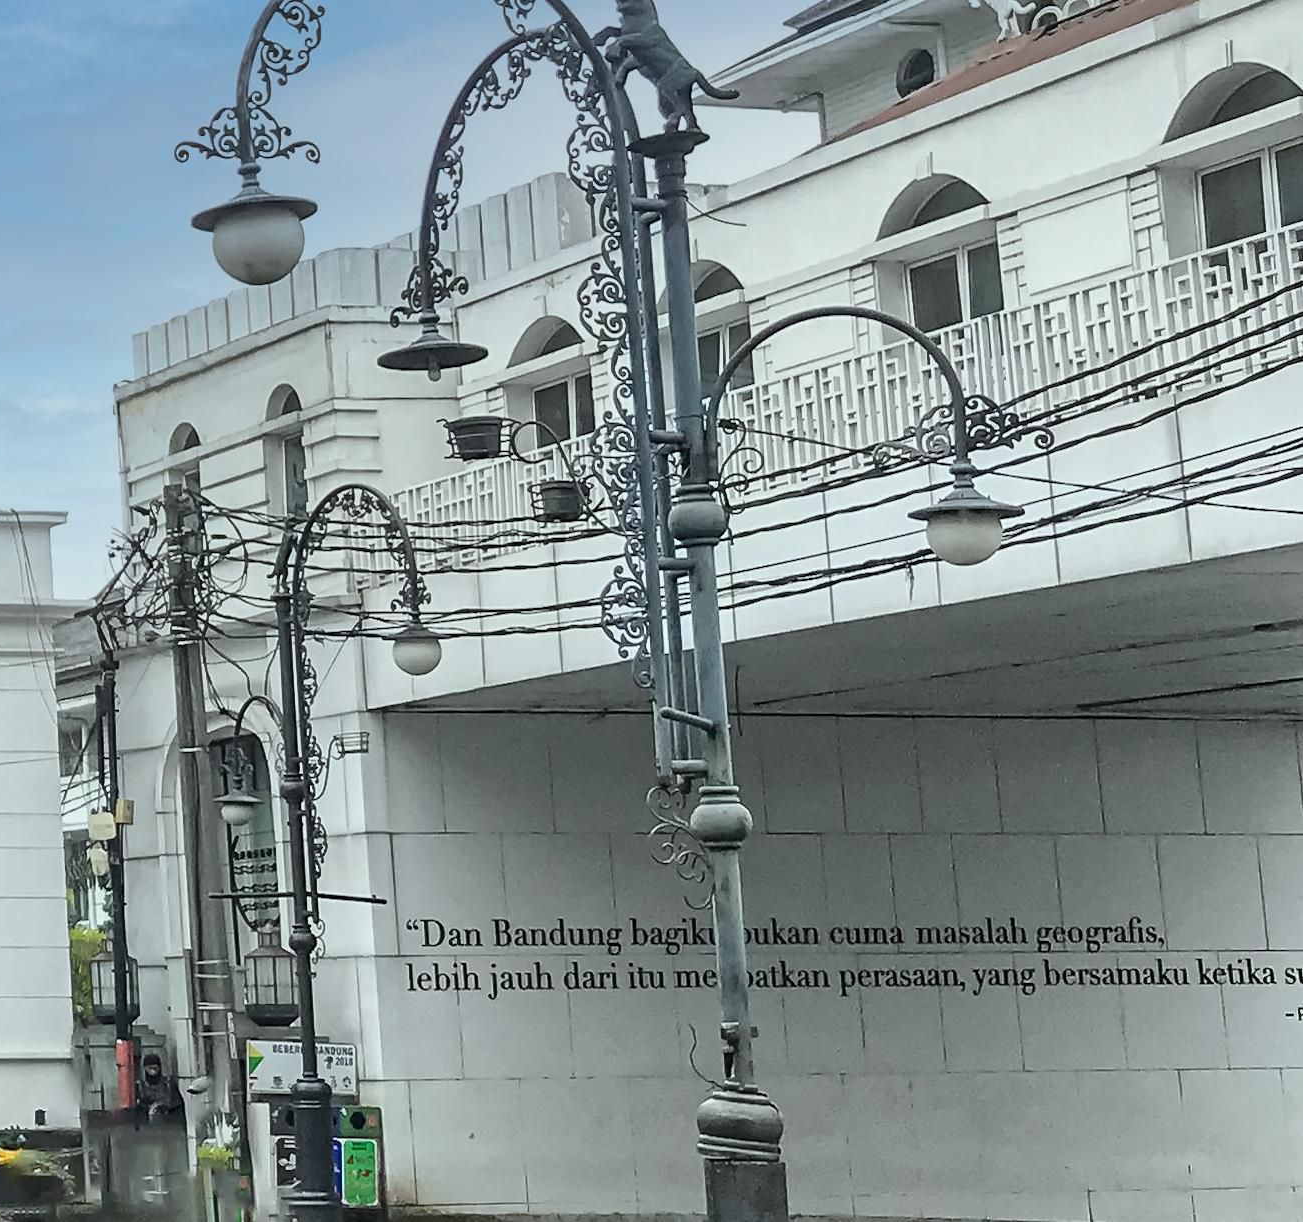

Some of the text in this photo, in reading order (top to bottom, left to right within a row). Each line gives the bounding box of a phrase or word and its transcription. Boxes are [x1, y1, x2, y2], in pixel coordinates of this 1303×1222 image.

[493, 917, 624, 956] Bandung
[829, 924, 905, 946] cuma
[915, 916, 1029, 946] masalah
[1036, 915, 1167, 954] geografis,
[405, 961, 482, 991] lebih
[487, 961, 552, 1001] jauh
[563, 961, 619, 991] dari
[628, 962, 666, 991] itu
[673, 958, 831, 990] meatkan
[839, 965, 967, 998] perasaan,
[972, 965, 1038, 996] yang
[1042, 958, 1191, 987] bersamaku
[1197, 957, 1278, 986] ketika
